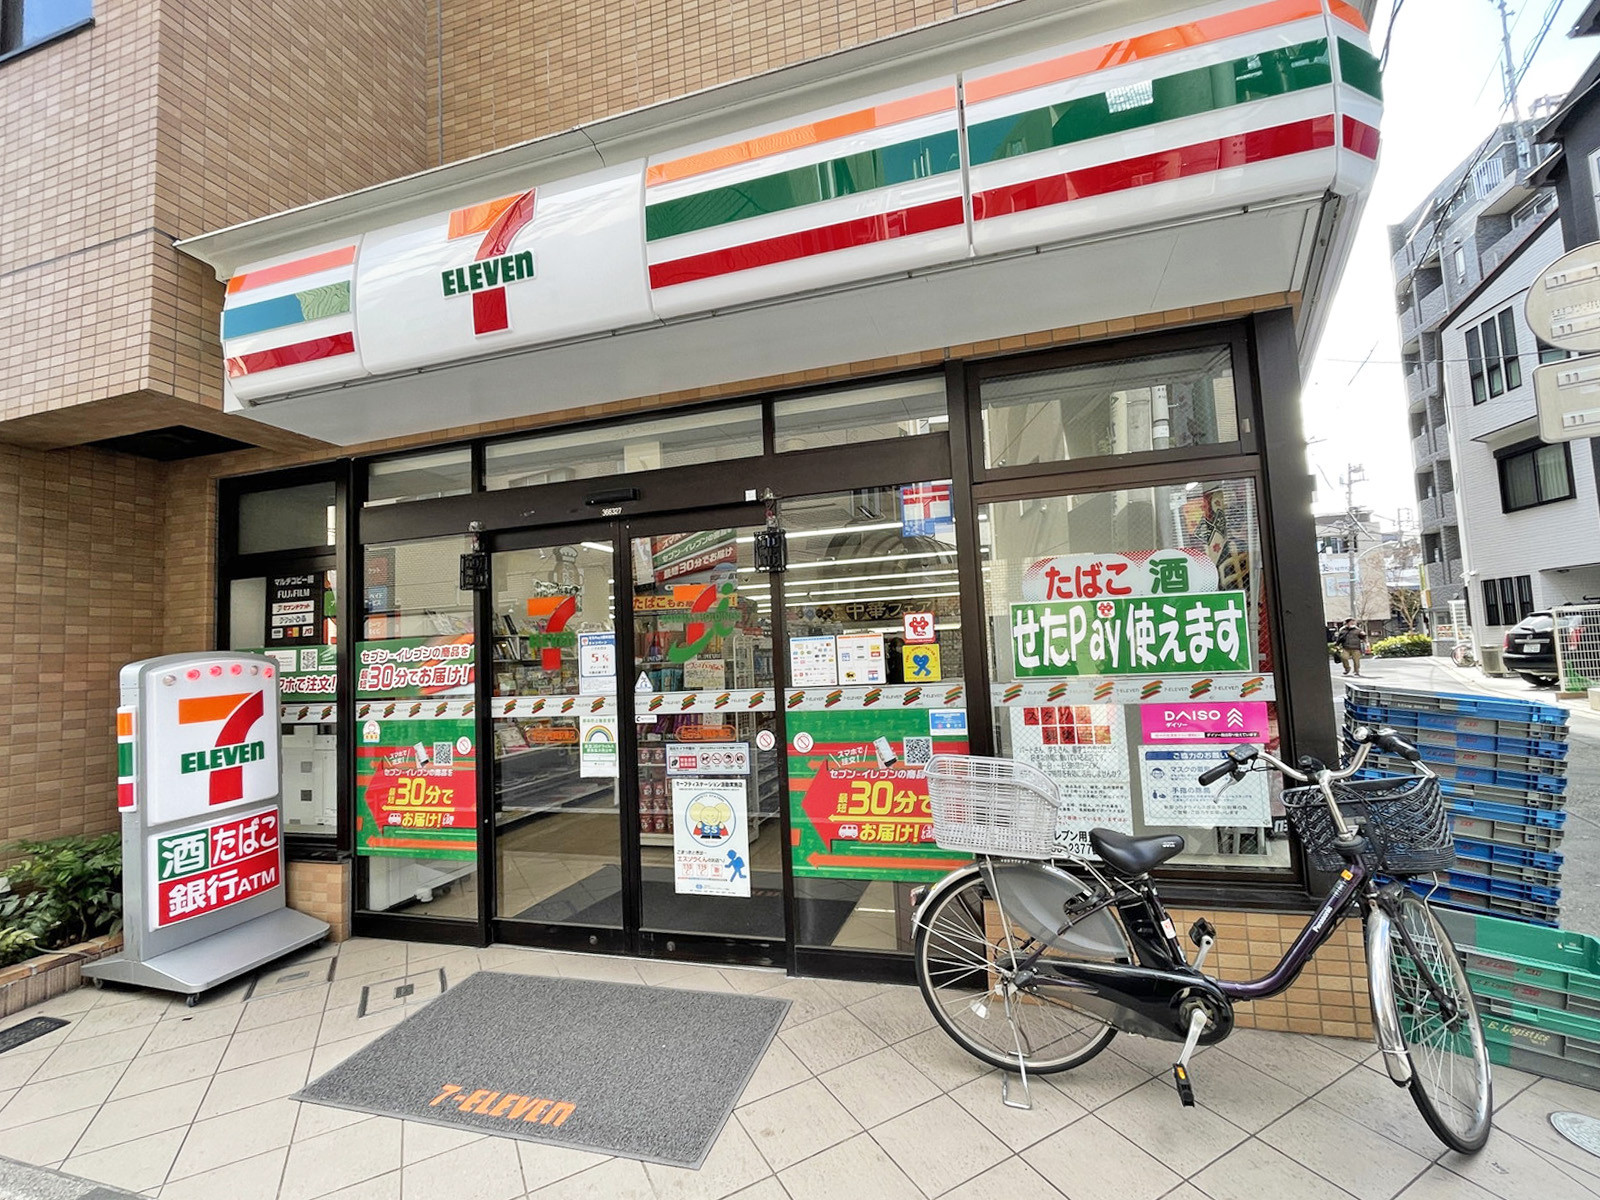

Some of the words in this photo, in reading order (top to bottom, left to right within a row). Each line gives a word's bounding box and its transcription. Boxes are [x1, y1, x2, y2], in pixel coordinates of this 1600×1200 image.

[1045, 562, 1132, 600] たばこ
[1149, 557, 1189, 594] 酒
[847, 601, 930, 620] 中華フェア
[1013, 599, 1243, 669] せたPay使えます
[1164, 710, 1221, 721] DAISO
[212, 815, 278, 862] たばこ
[859, 823, 921, 843] お届け!
[1055, 829, 1092, 843] レブン用
[162, 831, 206, 879] 酒
[1312, 905, 1334, 933] Panasonic
